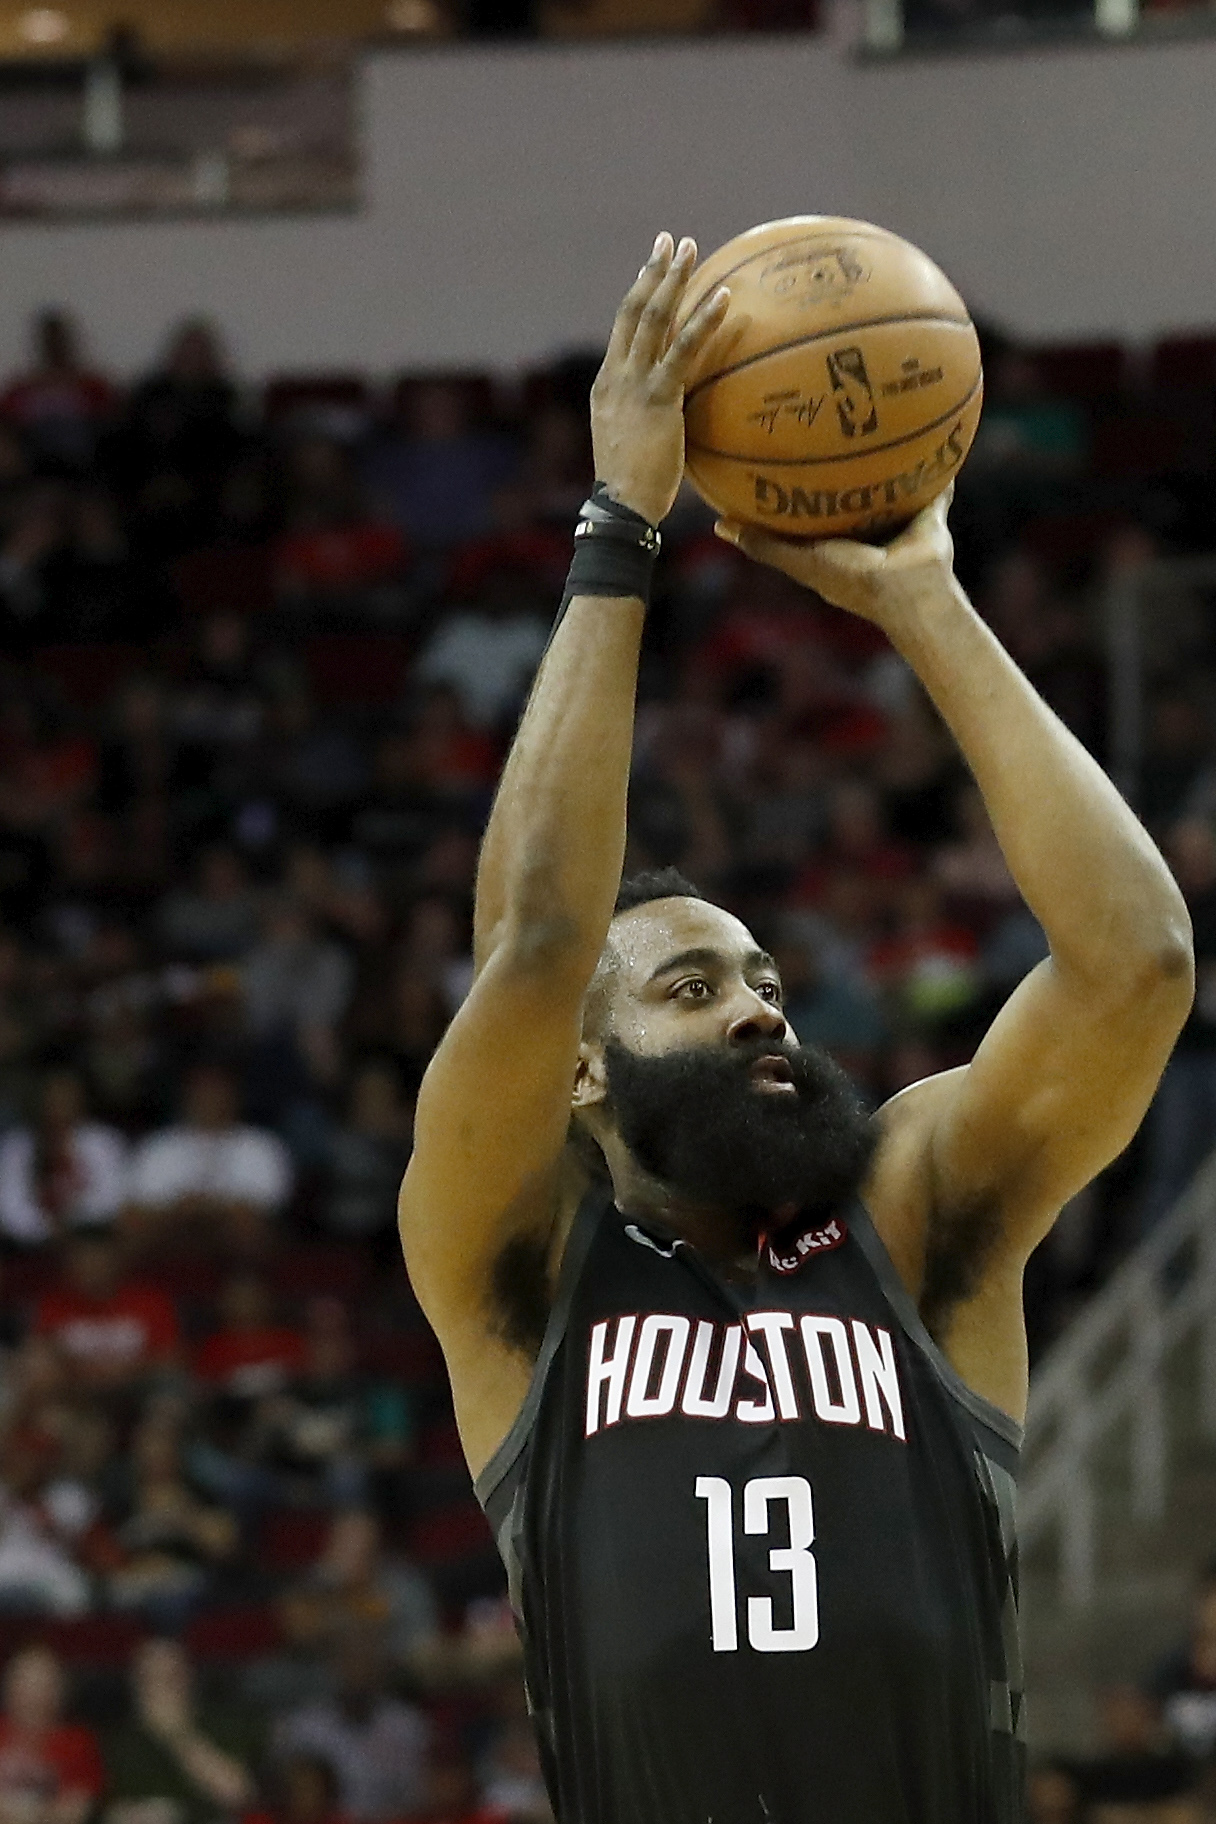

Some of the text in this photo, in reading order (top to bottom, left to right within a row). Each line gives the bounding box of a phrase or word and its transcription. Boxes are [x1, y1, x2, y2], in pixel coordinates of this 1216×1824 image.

[754, 422, 964, 518] SPALDING
[585, 1312, 907, 1442] HOUSTON
[695, 1476, 819, 1653] 13
